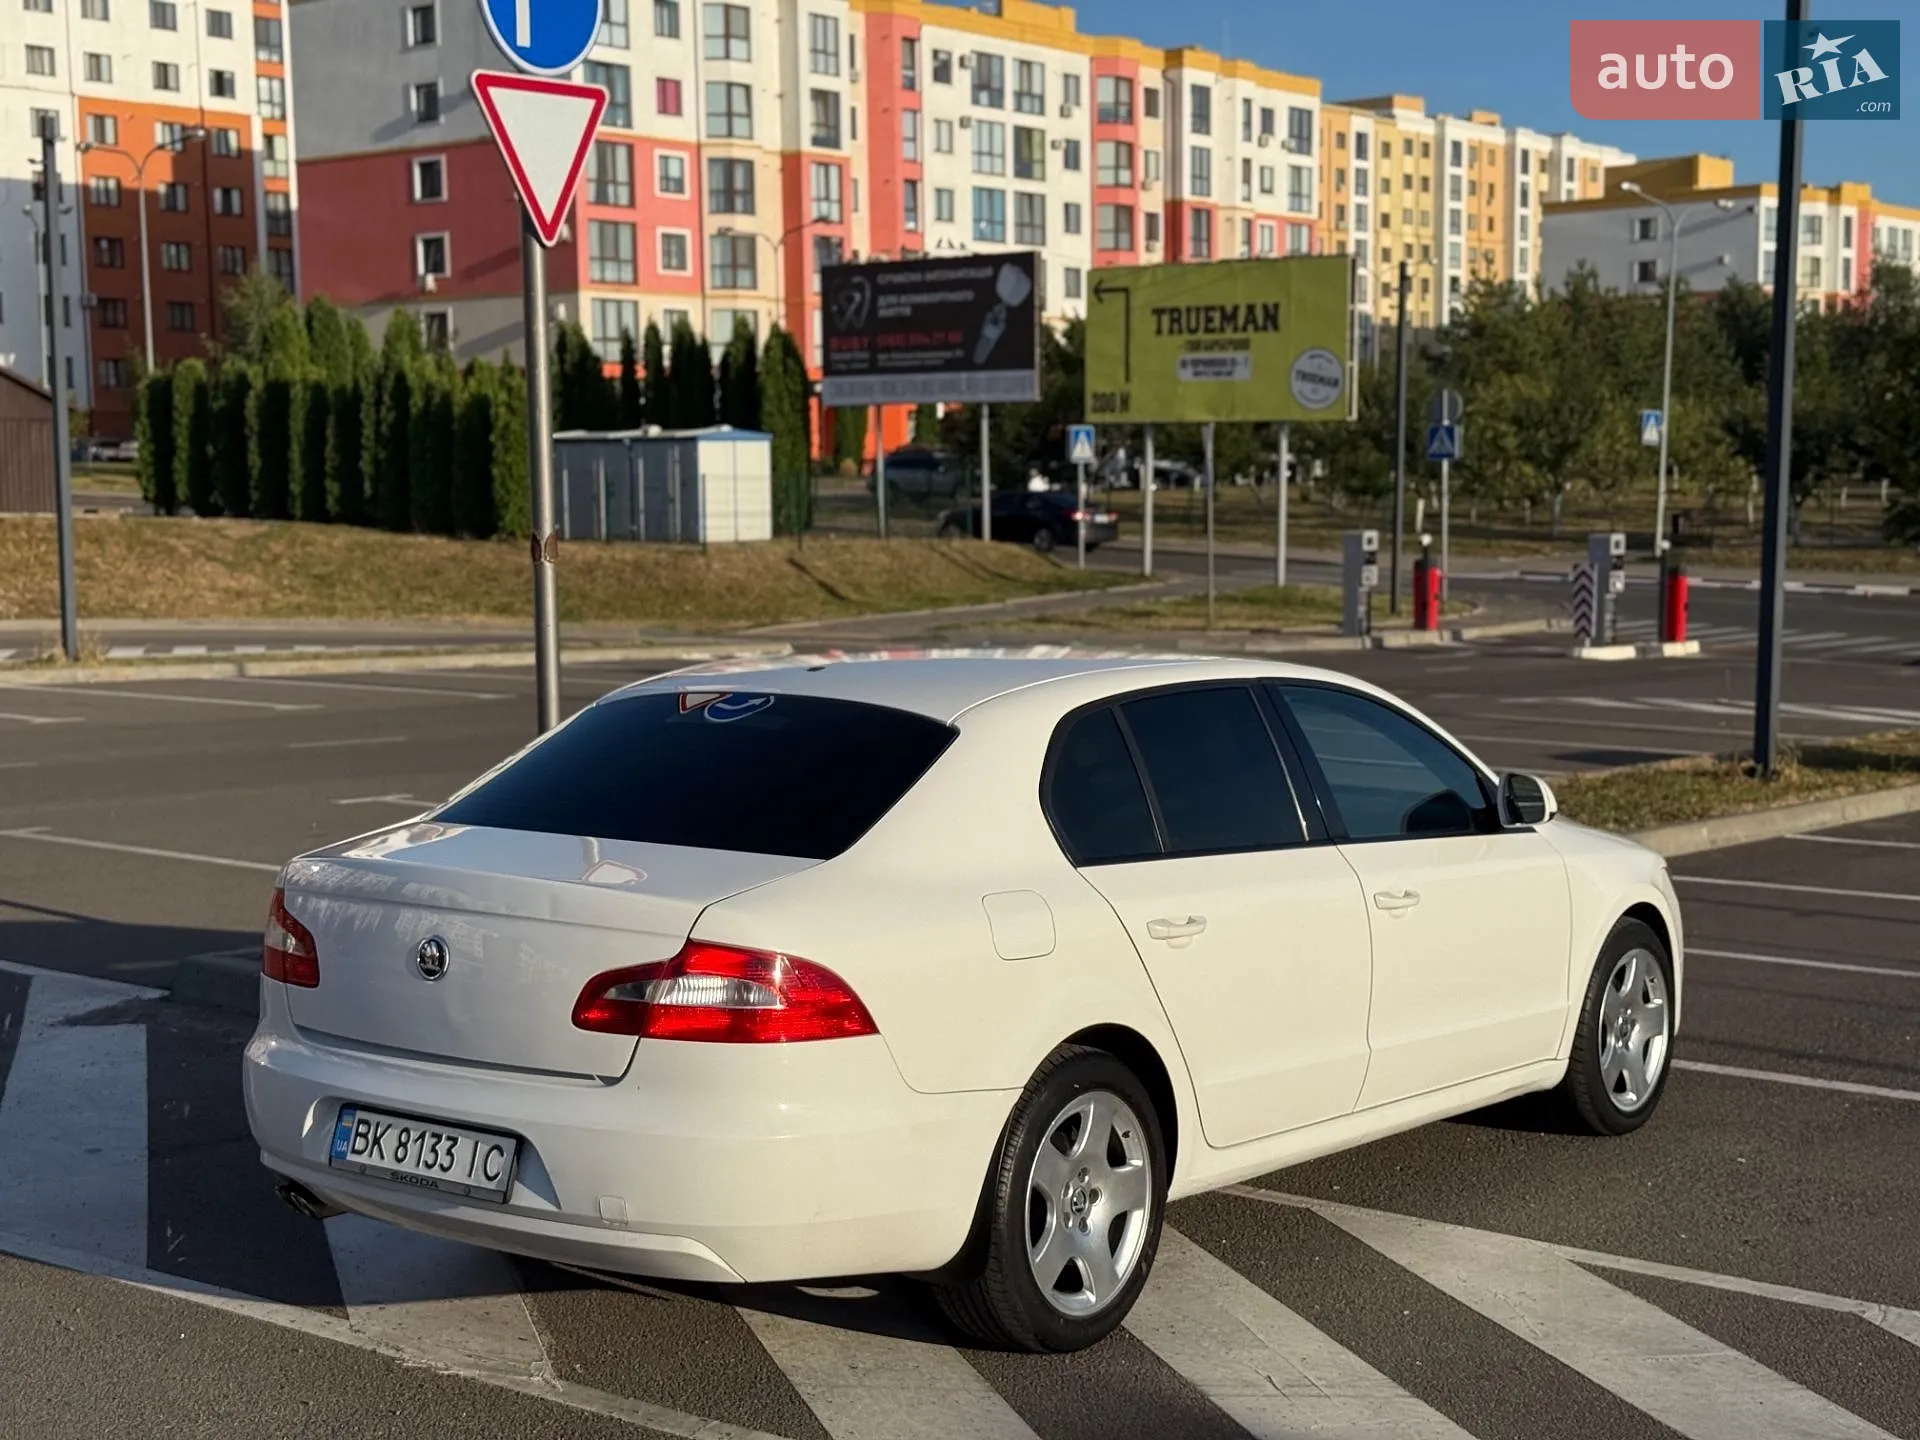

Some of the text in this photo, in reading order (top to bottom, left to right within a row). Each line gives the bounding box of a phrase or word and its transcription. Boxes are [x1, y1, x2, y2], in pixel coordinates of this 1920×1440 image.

[1152, 303, 1280, 336] TRUEMAN
[336, 1141, 348, 1152] UA
[350, 1117, 504, 1182] BK 8133 IC
